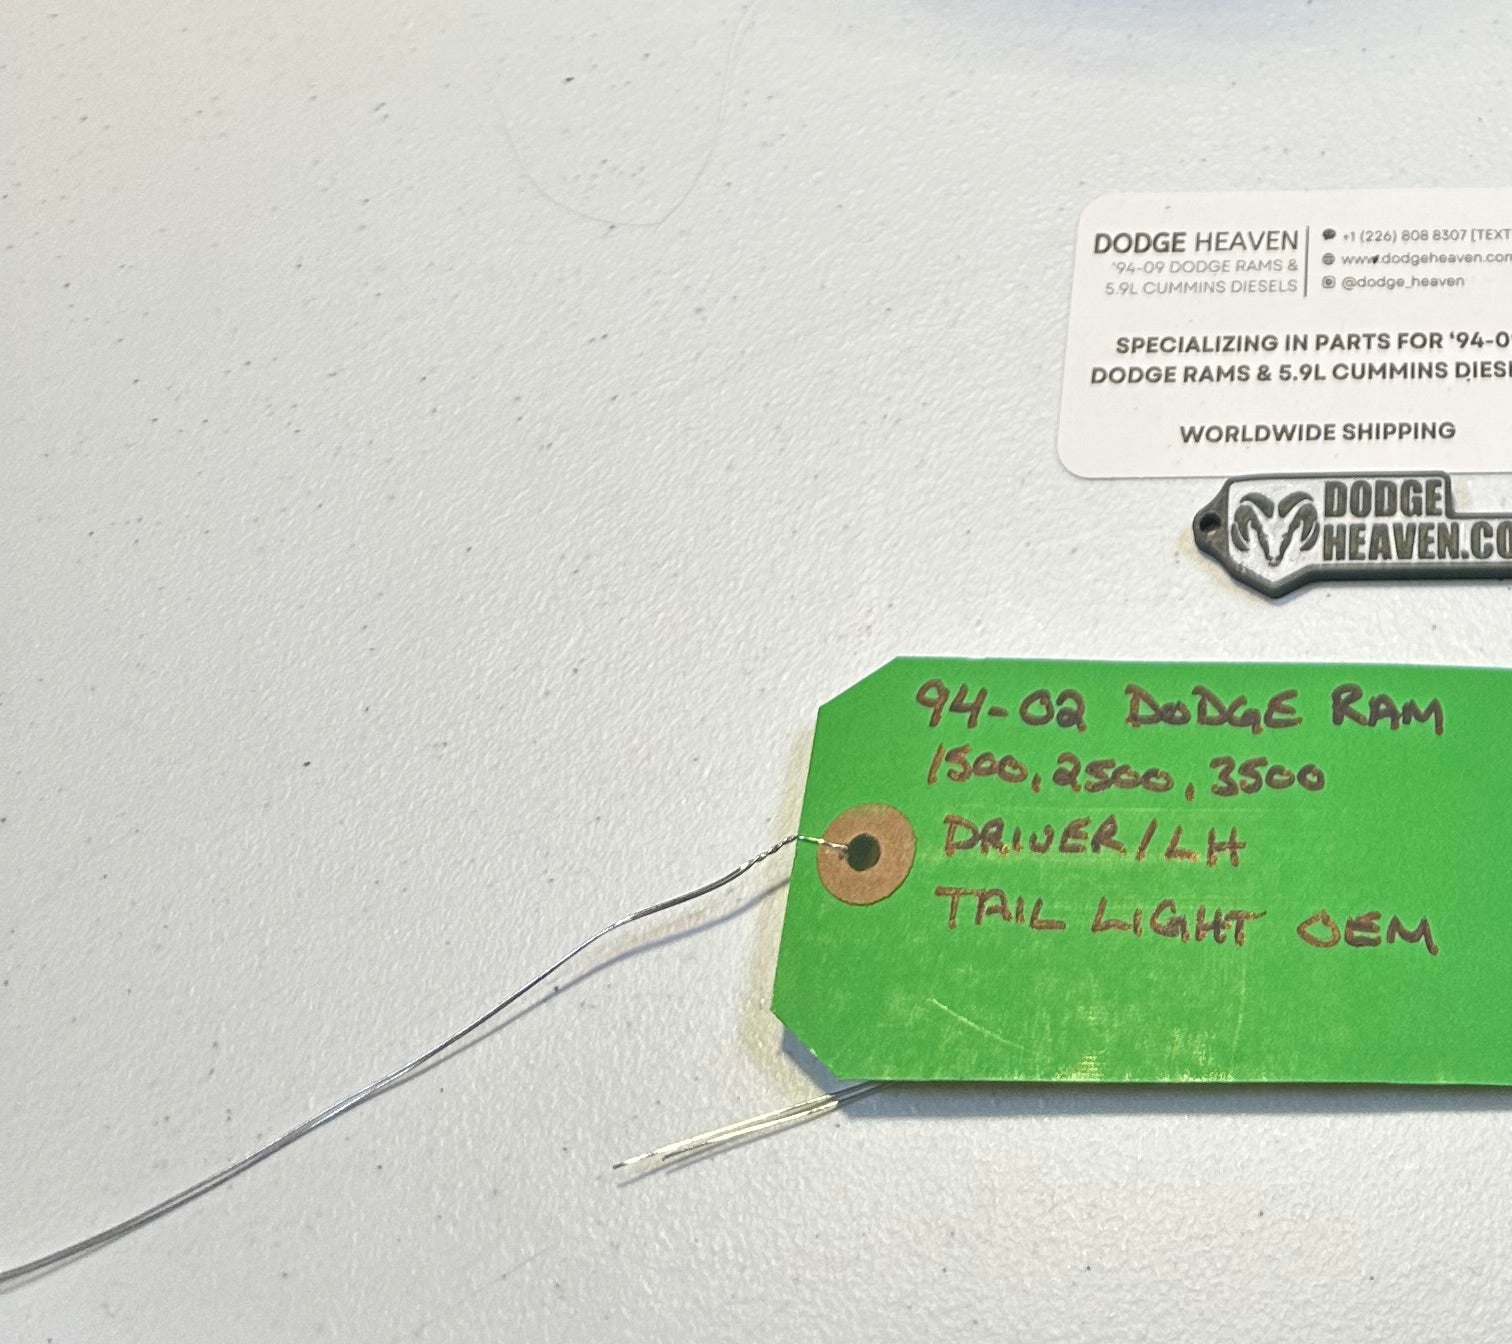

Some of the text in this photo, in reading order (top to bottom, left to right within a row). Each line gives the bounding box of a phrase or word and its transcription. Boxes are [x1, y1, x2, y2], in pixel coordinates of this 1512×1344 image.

[1094, 230, 1298, 254] DODGE HEAVEN
[1360, 230, 1397, 243] (226)
[1401, 230, 1429, 241] 808
[1432, 229, 1467, 241] 8307
[1471, 228, 1512, 242] [TEXT
[1169, 260, 1230, 273] DODGE
[1236, 259, 1283, 272] RAMS
[1287, 259, 1298, 271] &
[1105, 279, 1298, 295] 5.9L CUMMINS DIESELS
[1341, 275, 1465, 290] @dodge_heaven
[1116, 334, 1279, 354] SPECIALIZING
[1284, 333, 1308, 352] IN
[1314, 332, 1392, 352] PARTS
[1398, 331, 1444, 350] FOR
[1090, 365, 1177, 385] DODGE
[1183, 364, 1251, 384] RAMS
[1257, 364, 1272, 382] &
[1278, 362, 1326, 382] 5.9L
[1331, 361, 1448, 381] CUMMINS
[1180, 421, 1456, 444] WORLDWIDE SHIPPING
[1323, 478, 1444, 518] DODGE
[915, 679, 1446, 736] 94-02 DODGE RAM
[935, 885, 1441, 956] TAIL LIGHT OEM
